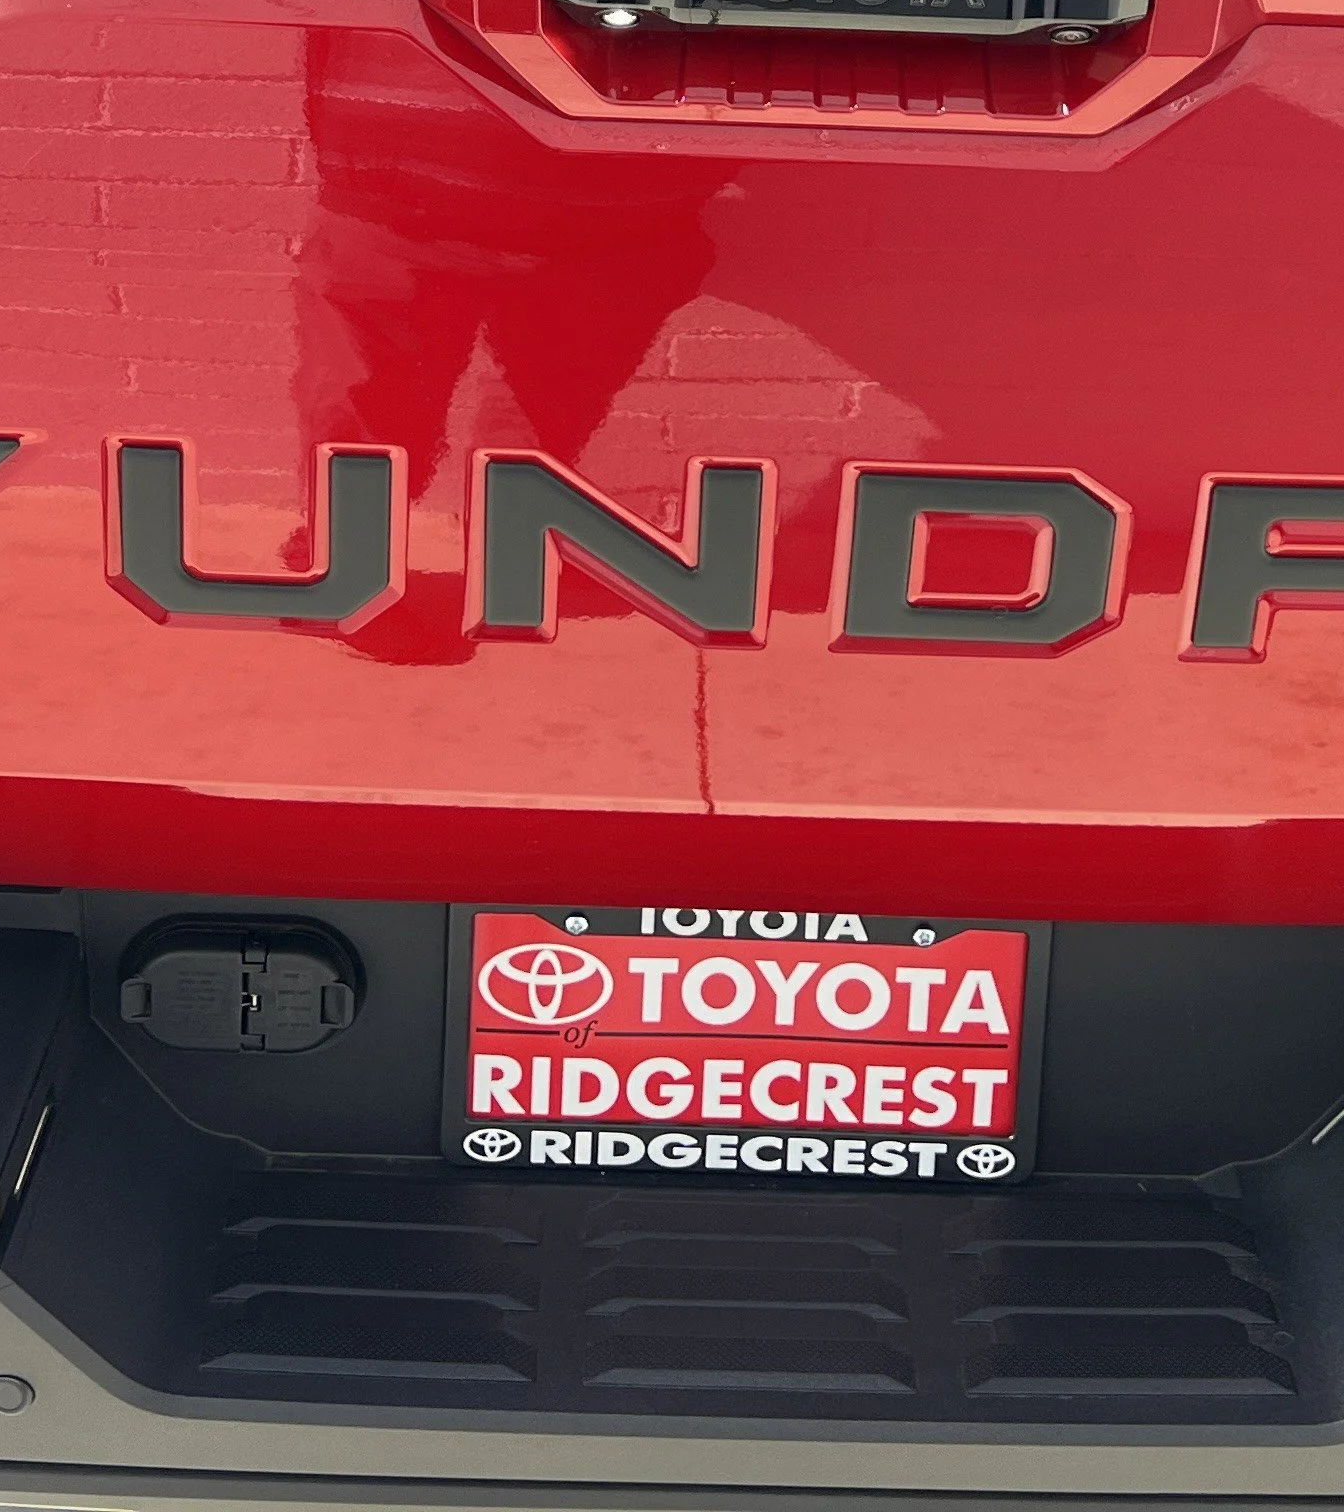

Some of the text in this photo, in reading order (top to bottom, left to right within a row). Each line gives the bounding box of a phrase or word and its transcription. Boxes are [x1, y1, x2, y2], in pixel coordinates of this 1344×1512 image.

[628, 956, 1010, 1035] TOYOTA
[563, 1020, 597, 1049] of
[471, 1053, 1009, 1128] RIDGECREST
[530, 1130, 948, 1177] RIDGECREST
